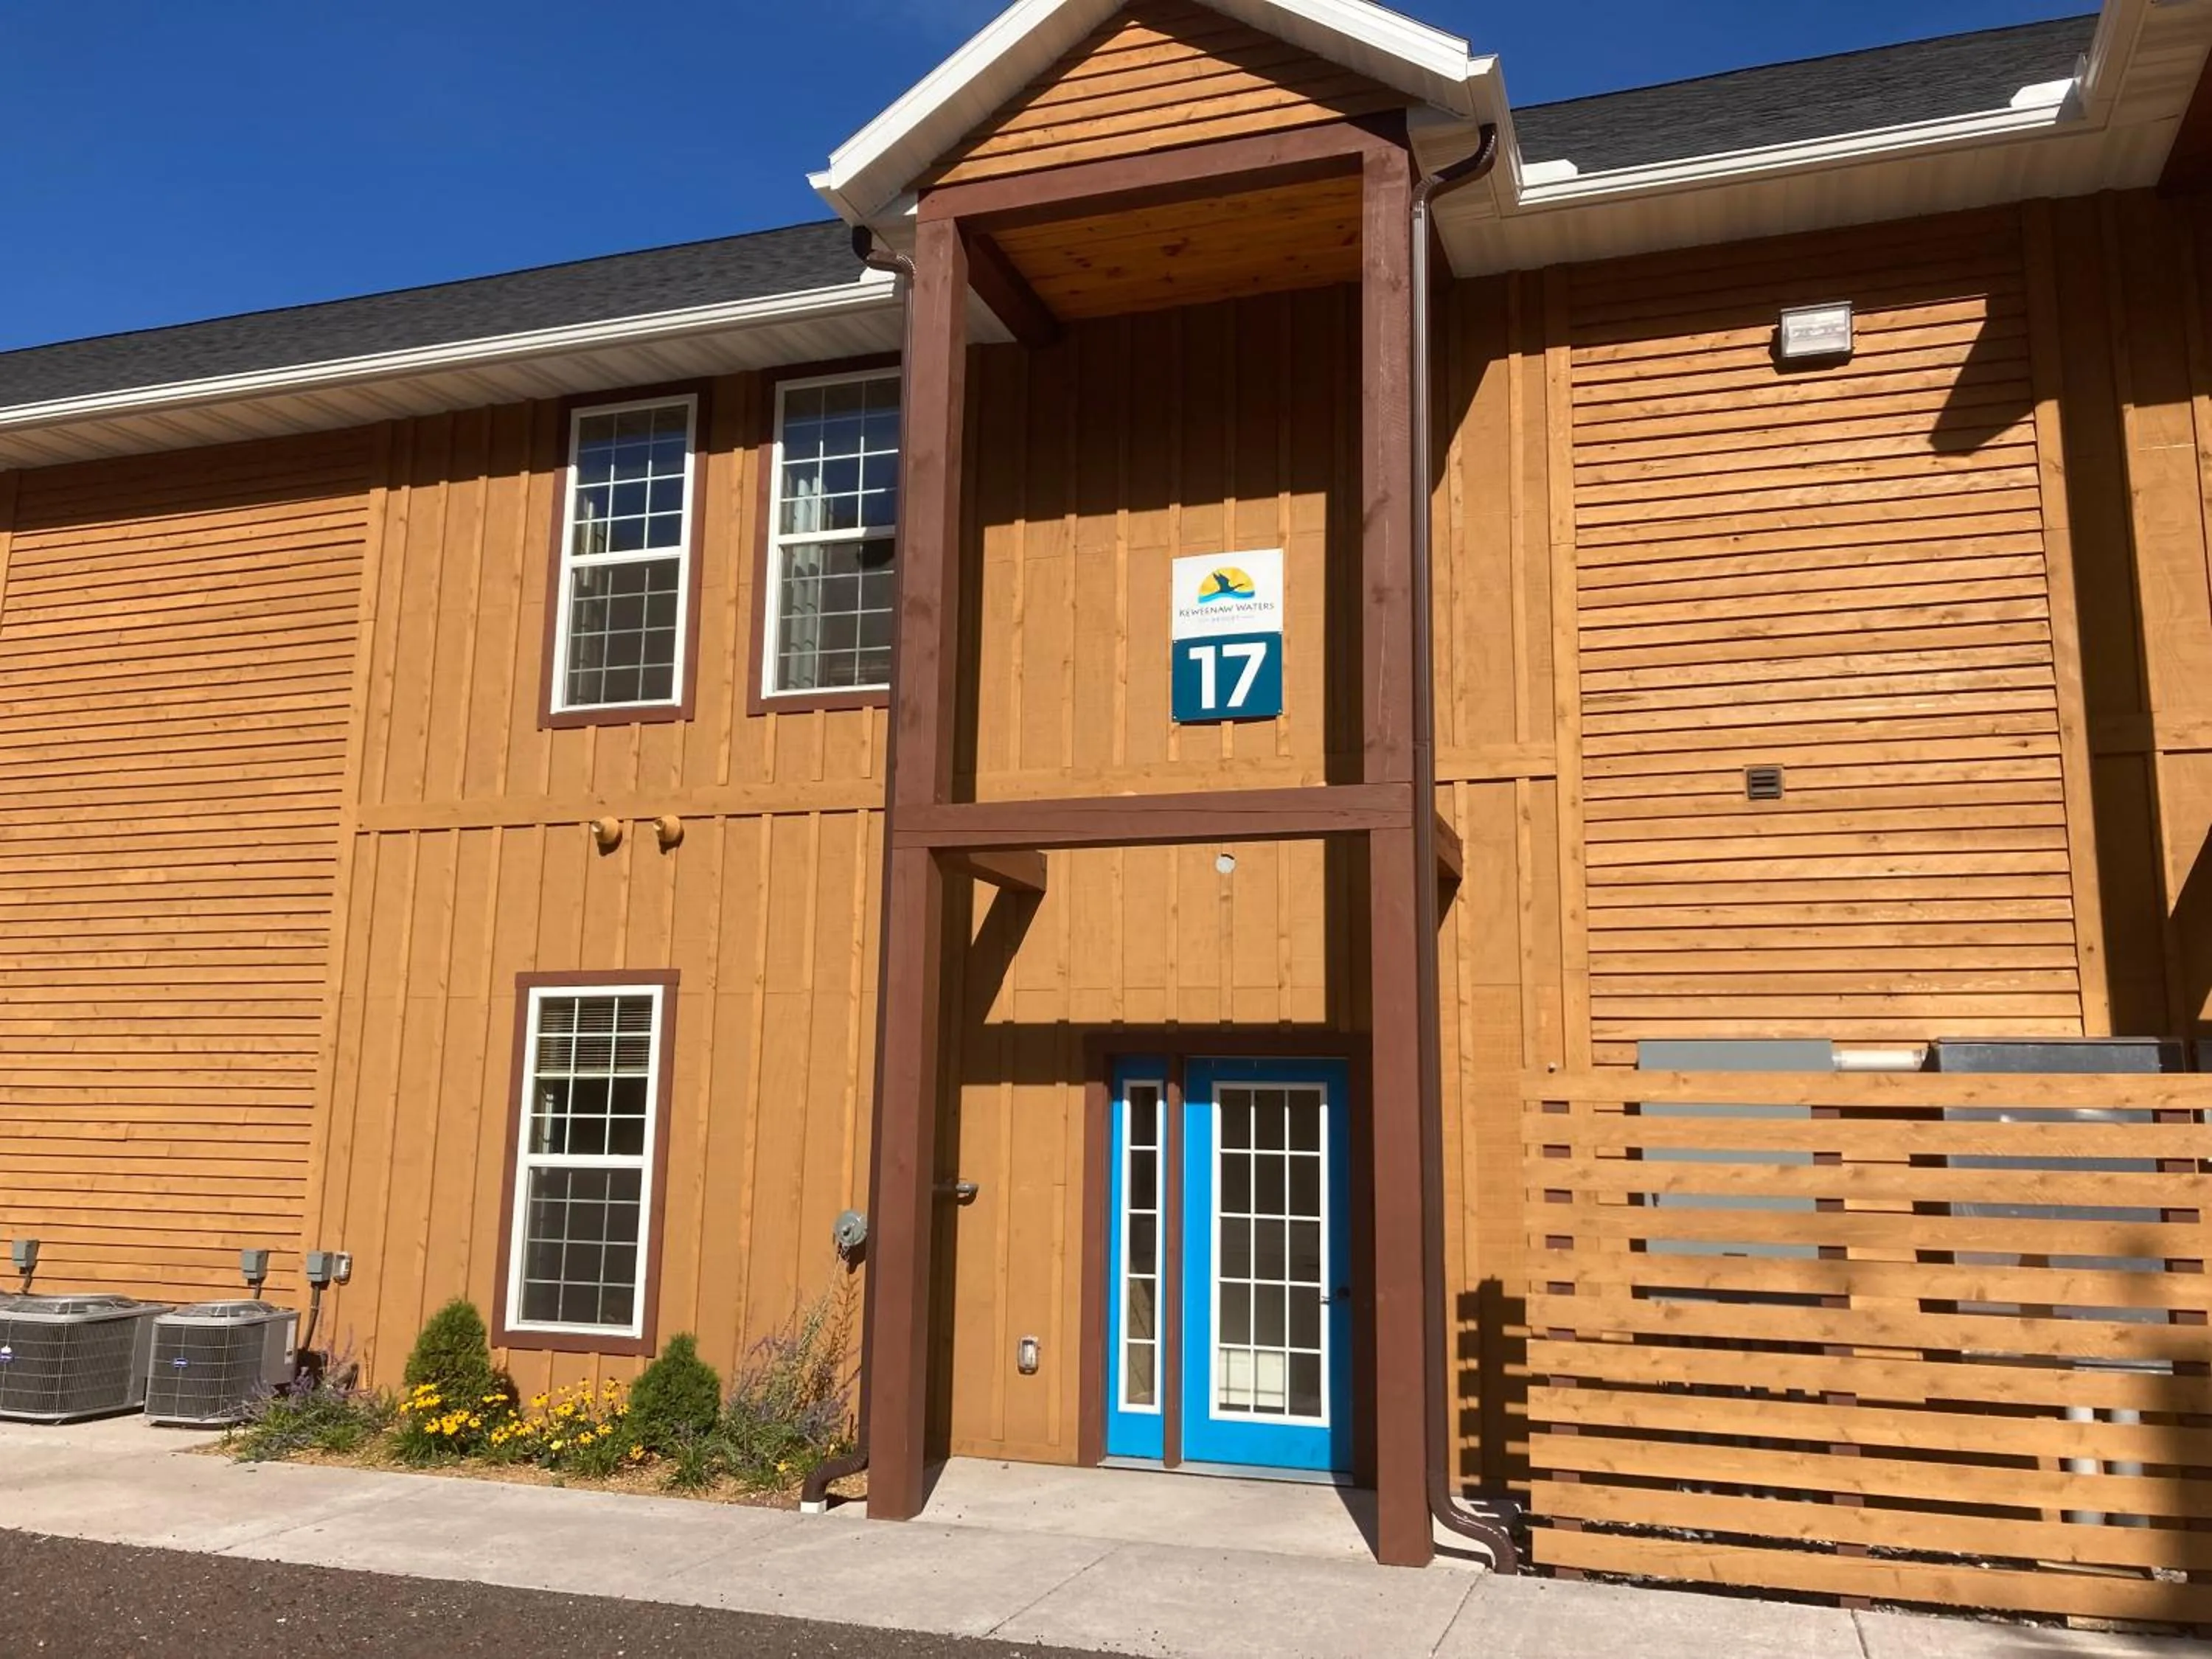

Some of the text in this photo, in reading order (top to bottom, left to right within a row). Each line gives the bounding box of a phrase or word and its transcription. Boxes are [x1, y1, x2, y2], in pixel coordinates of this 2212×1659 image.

[1179, 602, 1275, 618] KEWEENAW WATERS
[1189, 641, 1267, 709] 17
